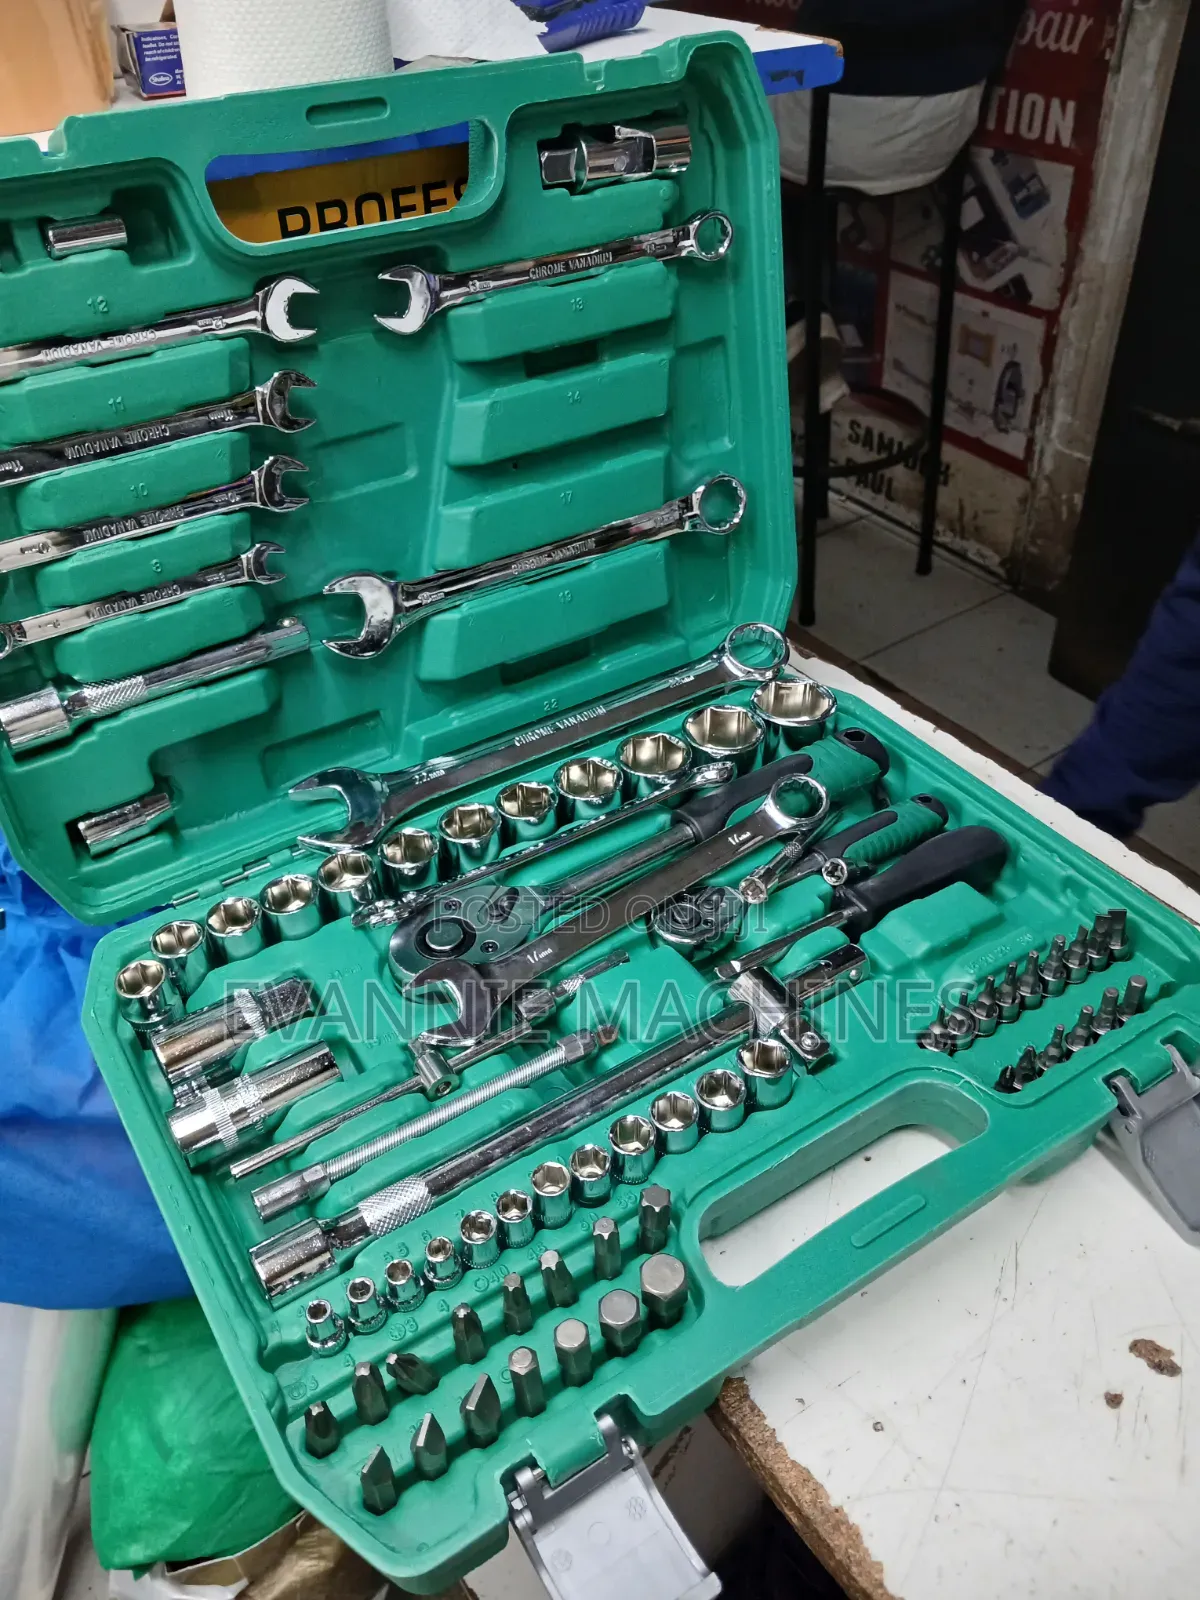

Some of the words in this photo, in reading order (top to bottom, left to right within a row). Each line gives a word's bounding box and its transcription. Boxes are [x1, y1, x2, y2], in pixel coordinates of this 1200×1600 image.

[87, 296, 109, 315] 12
[108, 396, 125, 413] 11
[124, 423, 171, 446] CHROME
[64, 434, 123, 460] VANADIUM
[543, 698, 559, 712] 22
[514, 723, 556, 748] CHROME
[557, 704, 607, 731] VANADIUM
